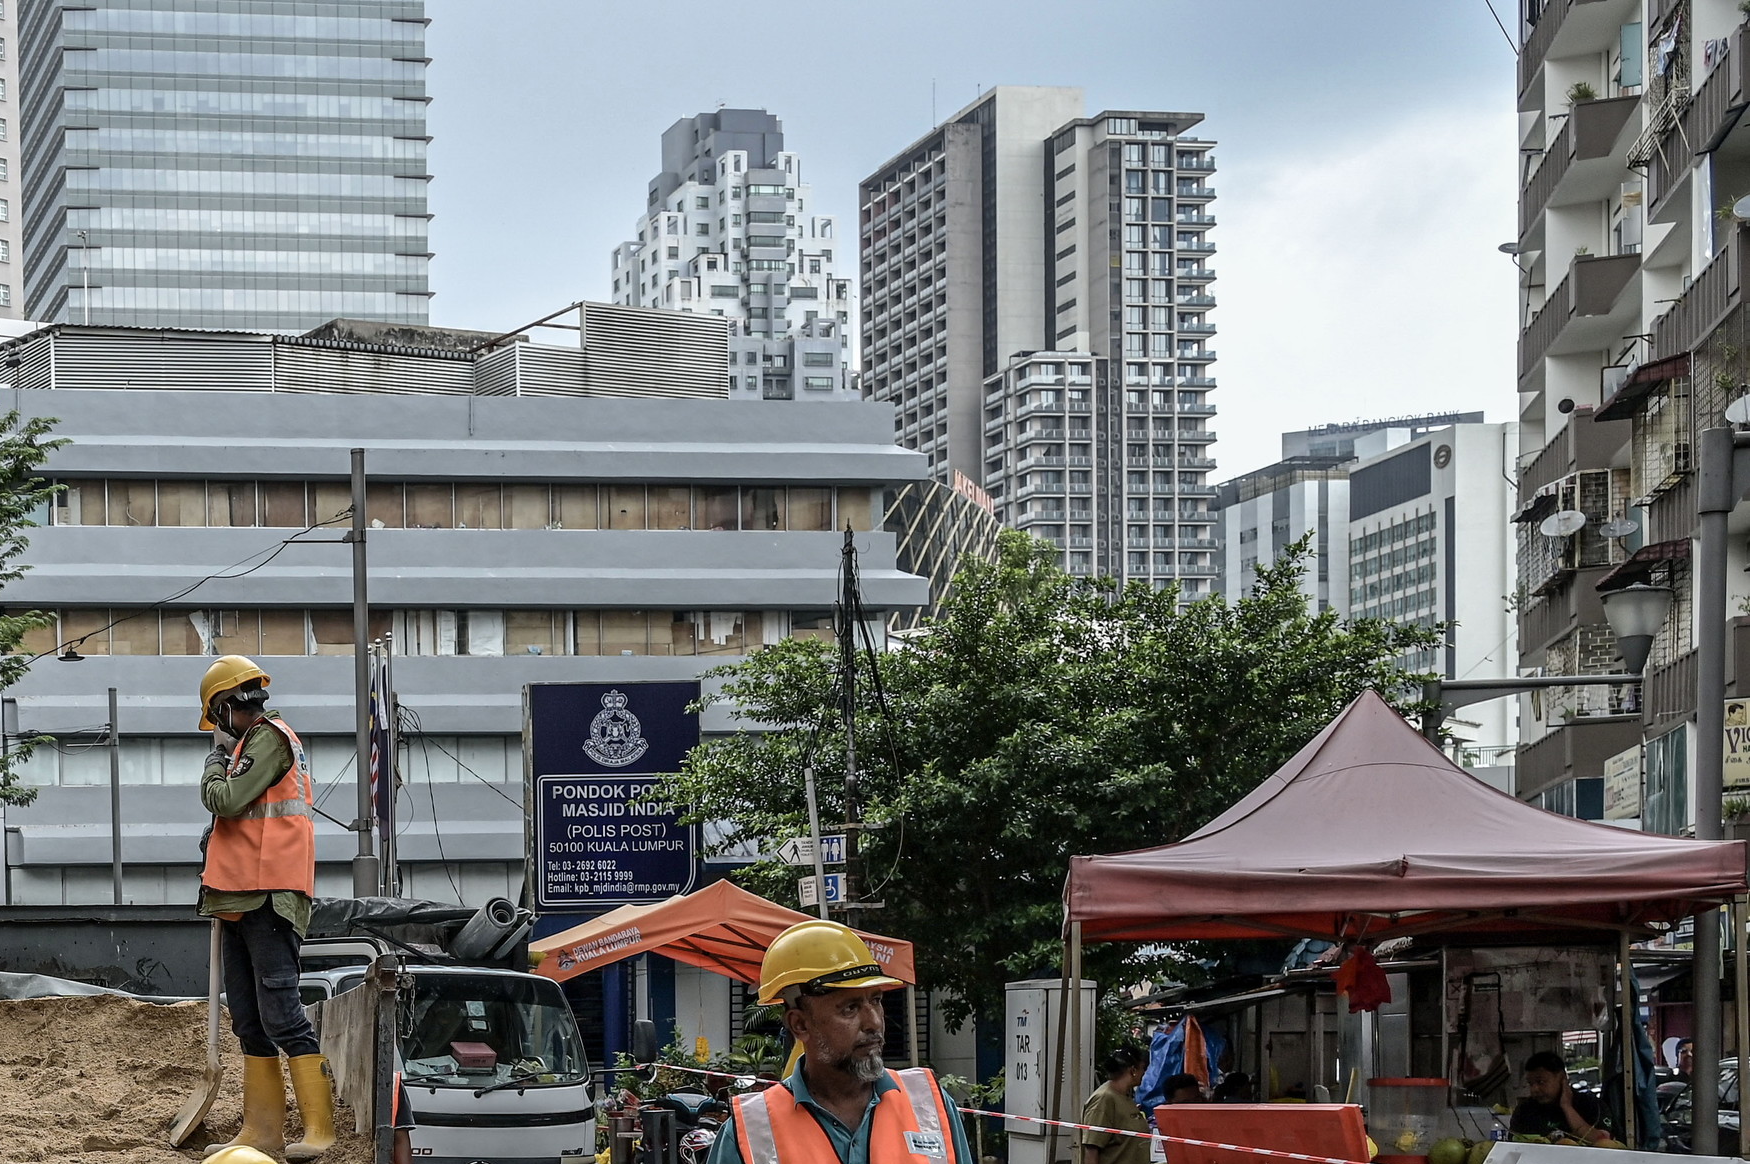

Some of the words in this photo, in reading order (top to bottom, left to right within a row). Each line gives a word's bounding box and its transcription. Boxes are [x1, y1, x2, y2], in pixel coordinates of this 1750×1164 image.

[1308, 420, 1360, 437] MENARA
[1362, 414, 1424, 431] BANGKOK
[1426, 410, 1461, 425] BANK
[552, 785, 626, 799] PONDOK
[562, 803, 625, 817] MASJID
[630, 802, 676, 816] INDIA
[567, 823, 616, 839] (POLIS
[620, 822, 666, 838] POST)
[549, 842, 584, 853] 50100
[587, 841, 629, 852] KUALA
[632, 840, 684, 851] LUMPUR
[547, 861, 560, 871] Tel:
[597, 860, 616, 870] 6022
[547, 872, 578, 882] Hotline:
[614, 871, 633, 880] 9999
[547, 883, 572, 893] Email:
[574, 882, 680, 894] kpb_mjdindia@rmp.gov.my
[572, 940, 598, 957] DEWAN
[598, 926, 641, 947] BANDARAYA
[575, 947, 607, 964] KUALA
[606, 934, 643, 953] LUMPUR
[1016, 1016, 1027, 1028] TM
[1016, 1035, 1031, 1053] TAR
[1016, 1062, 1028, 1081] 013
